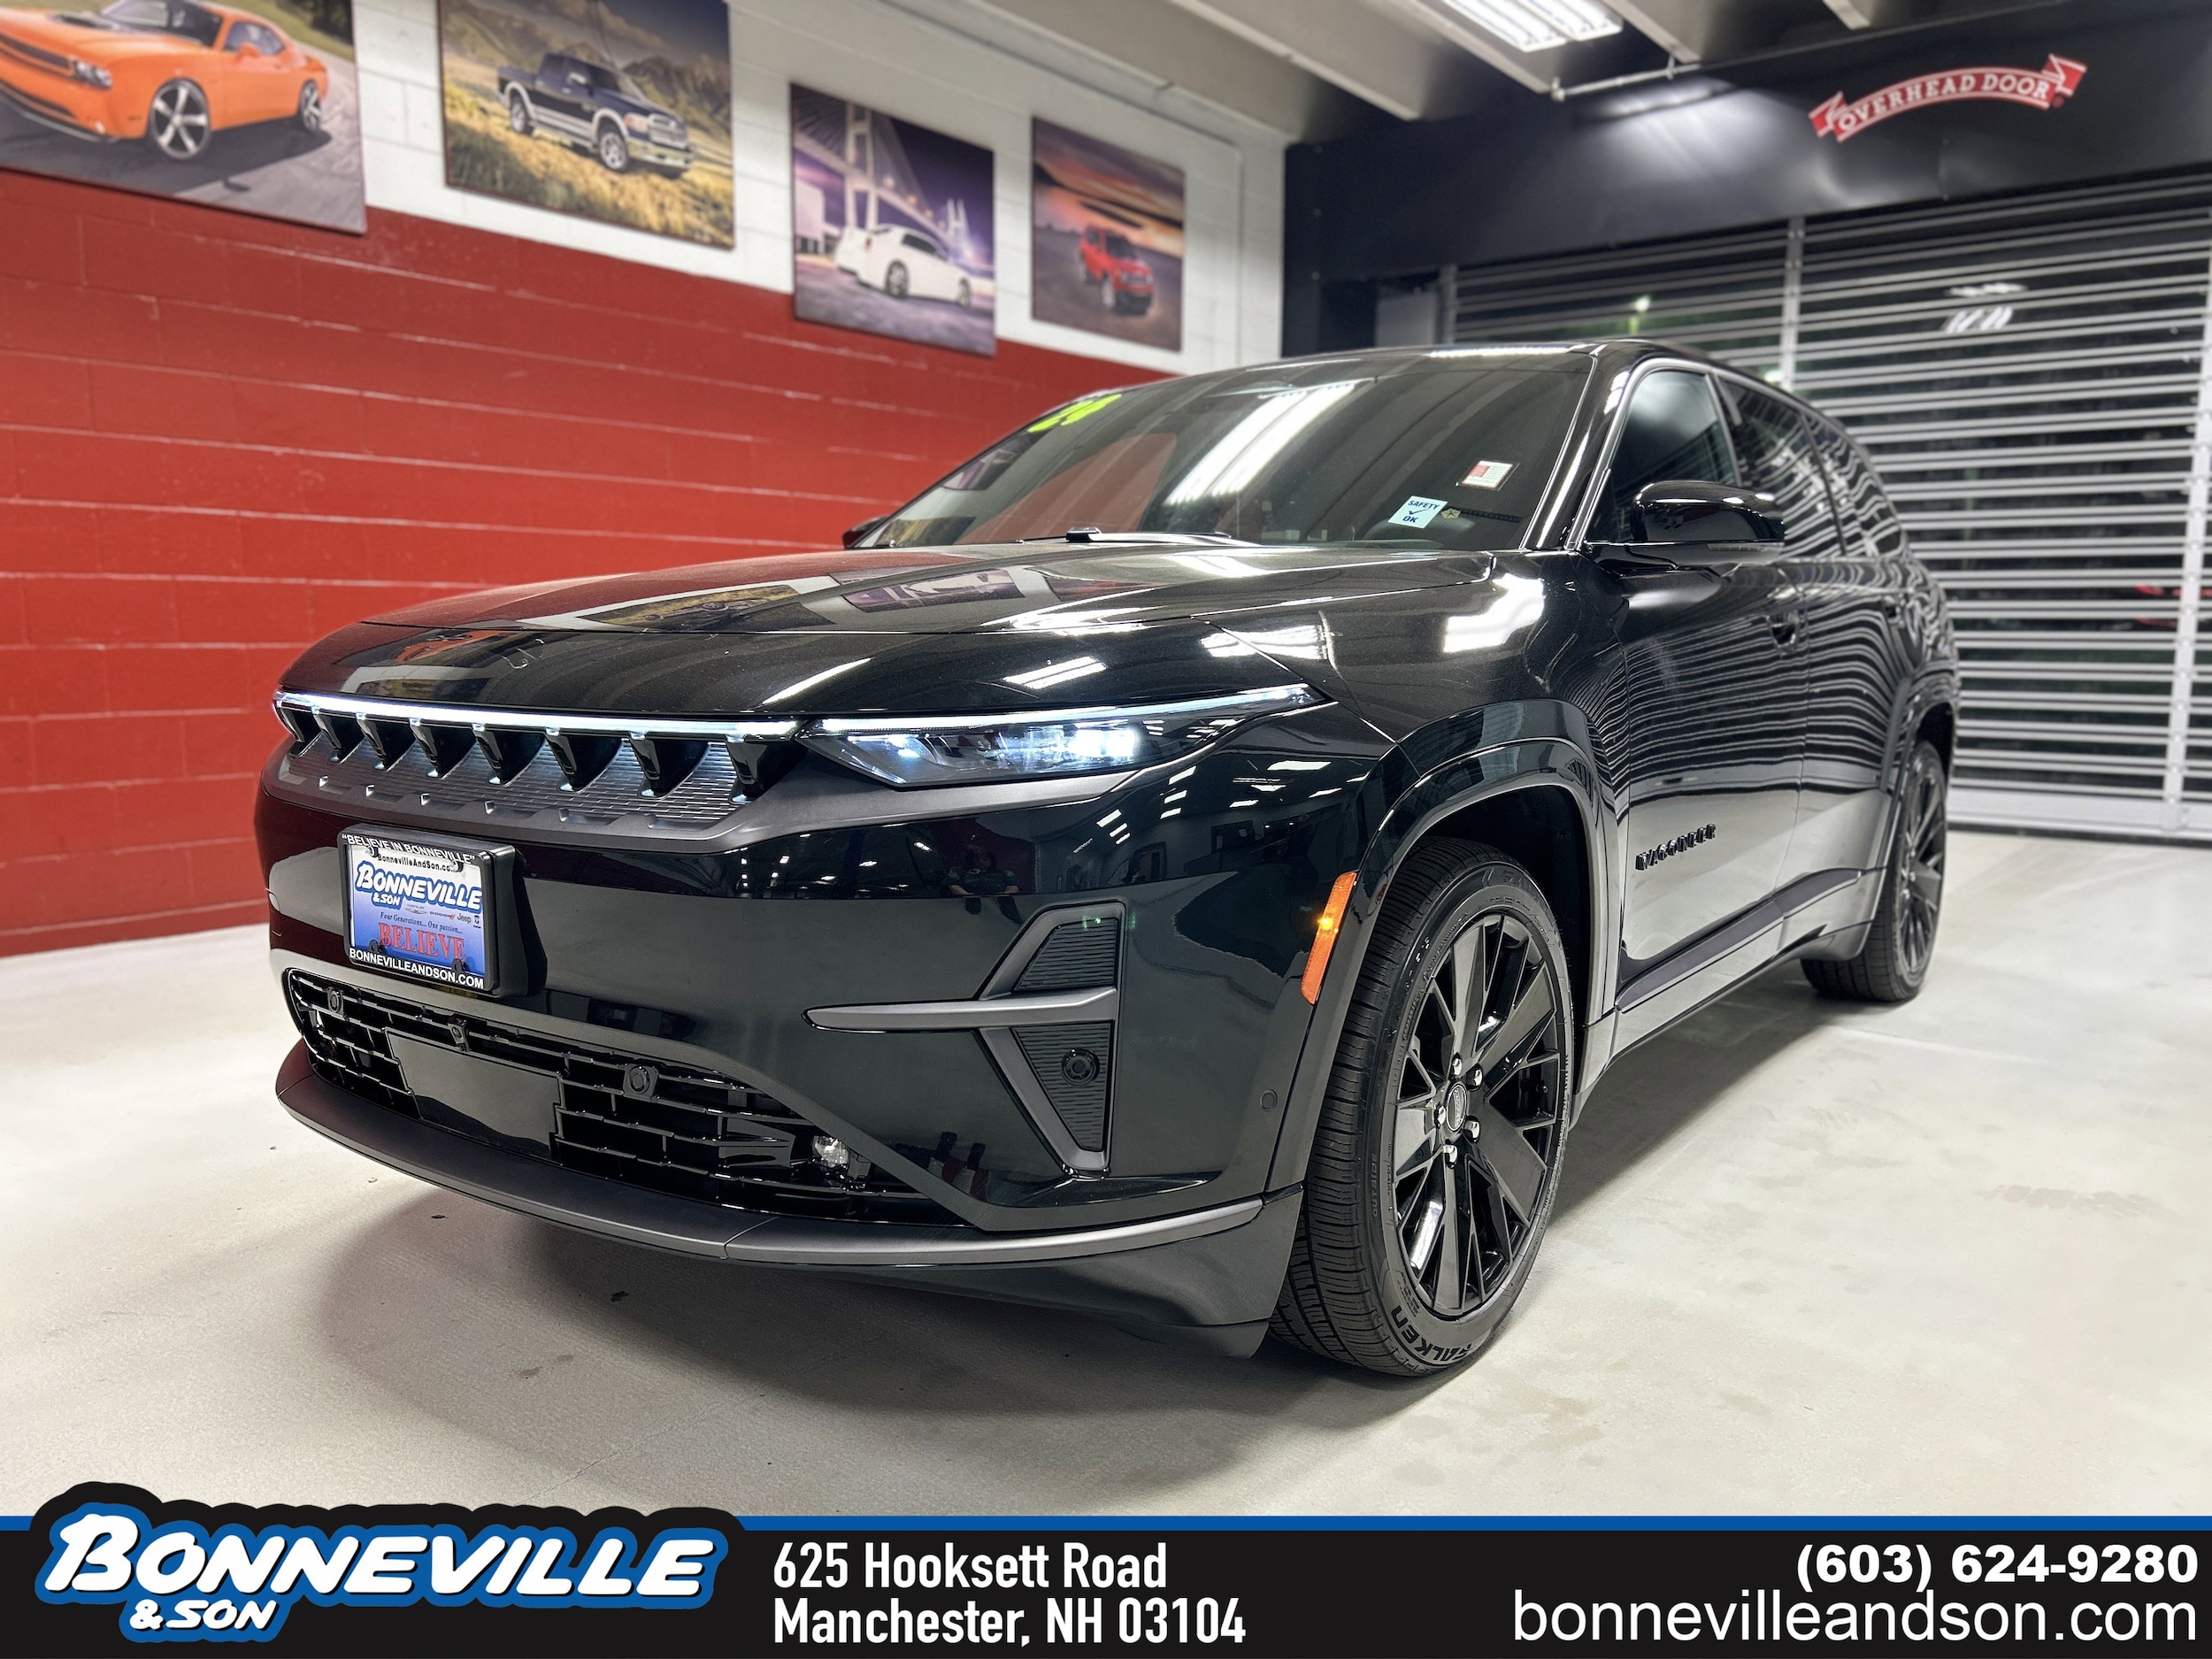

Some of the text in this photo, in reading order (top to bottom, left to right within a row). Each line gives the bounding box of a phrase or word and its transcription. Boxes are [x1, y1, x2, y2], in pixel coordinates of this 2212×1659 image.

[1838, 73, 2051, 131] OVERHEAD DOOR
[1402, 515, 1418, 524] OK
[1408, 500, 1440, 511] SAFETY
[390, 841, 403, 852] IN
[1635, 823, 1717, 871] WAGONEER
[378, 854, 459, 873] BonnevilleAndSon.co
[357, 864, 483, 910] BONNEVILLE
[380, 910, 393, 920] Four
[427, 920, 439, 930] One
[457, 913, 472, 925] Jeep
[379, 922, 465, 962] BELIEVE
[349, 948, 484, 989] BONNEVILLEANDSON.COM
[1391, 1305, 1473, 1362] FALKEN
